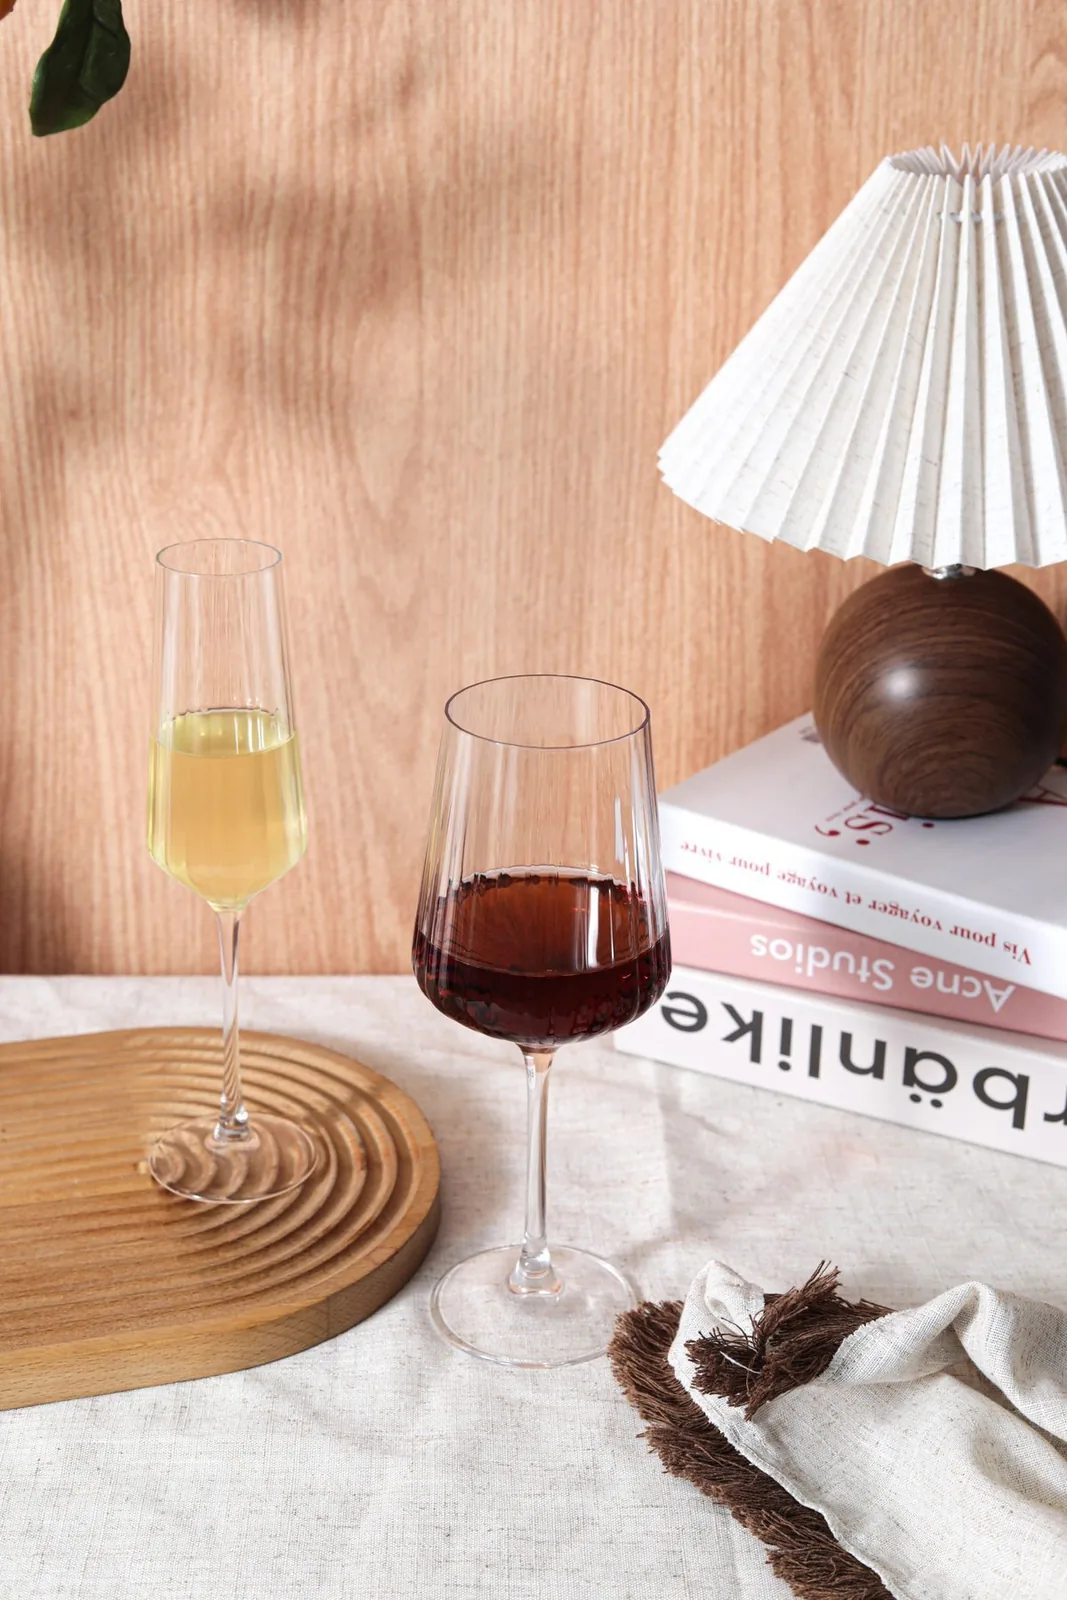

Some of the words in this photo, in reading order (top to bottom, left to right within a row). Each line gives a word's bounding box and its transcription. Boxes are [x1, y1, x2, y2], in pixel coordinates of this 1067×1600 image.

[729, 855, 771, 877] pour
[777, 871, 839, 898] voyage
[844, 891, 862, 905] et
[868, 900, 943, 931] voyager
[949, 925, 997, 948] pour
[750, 933, 896, 992] Studios
[1003, 942, 1032, 965] Vis
[910, 966, 1016, 1013] Acne
